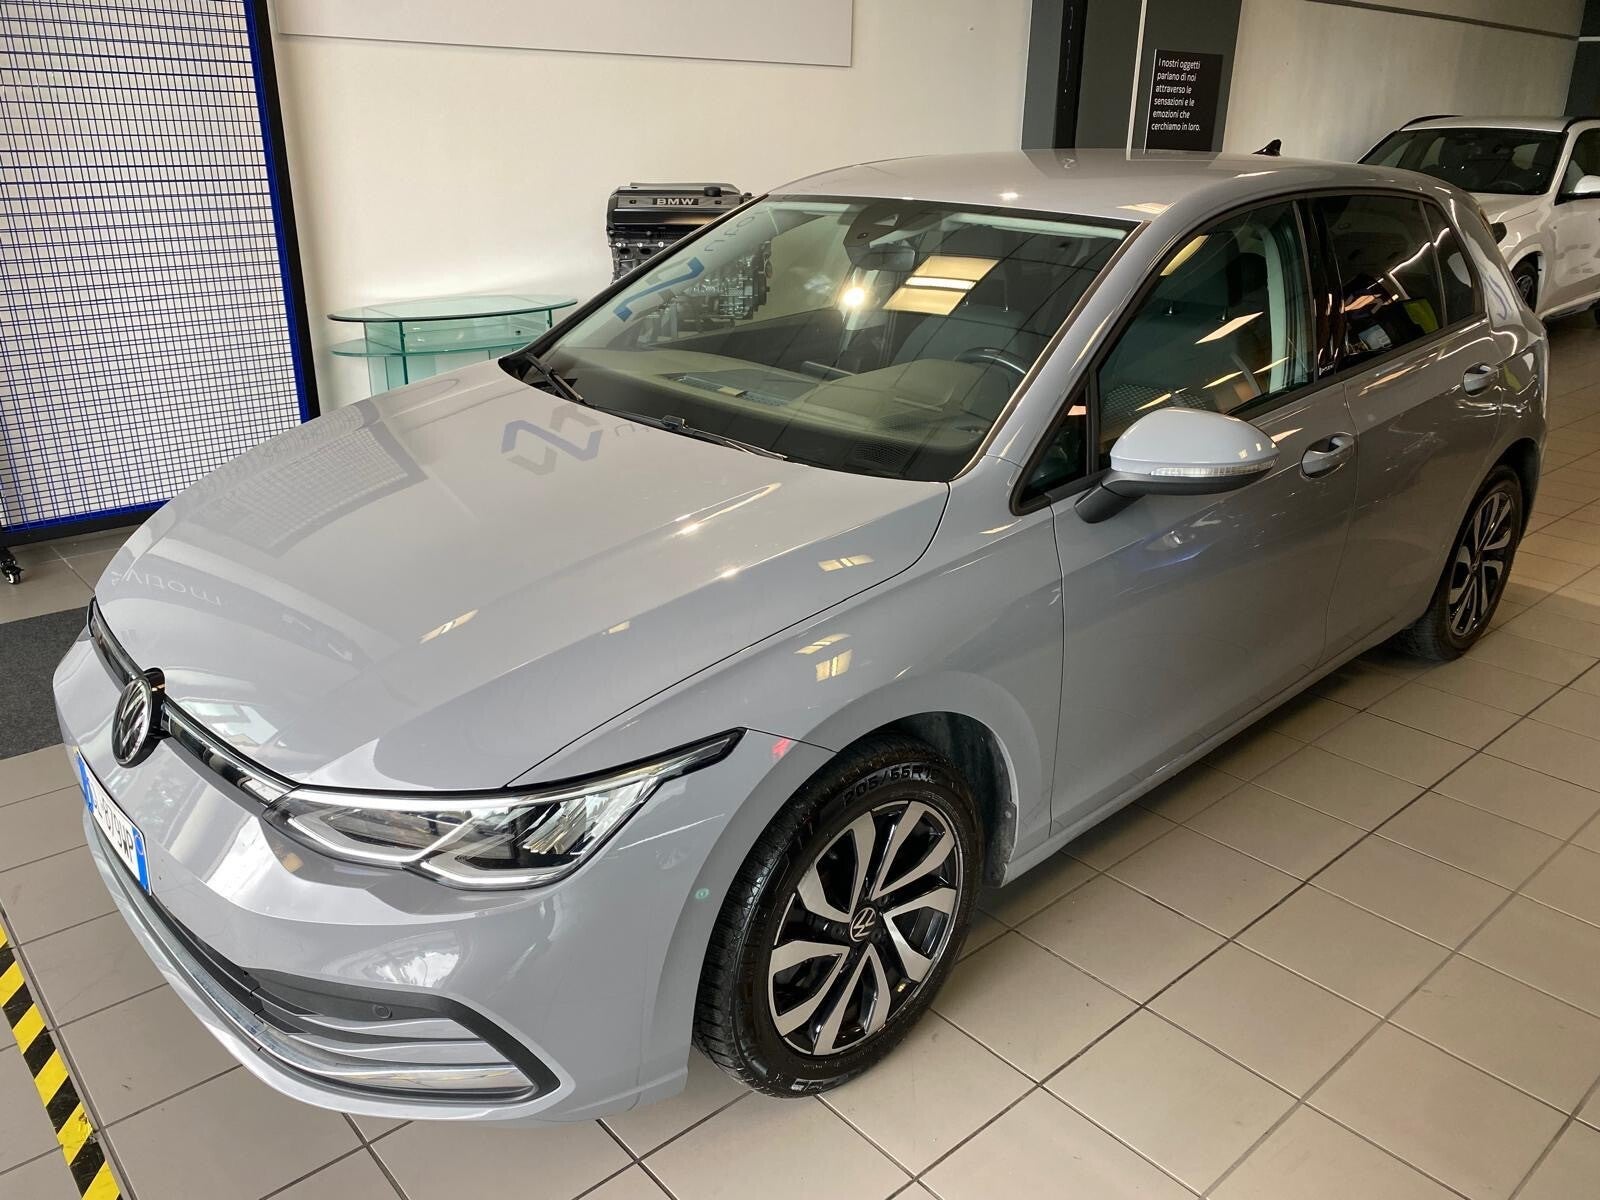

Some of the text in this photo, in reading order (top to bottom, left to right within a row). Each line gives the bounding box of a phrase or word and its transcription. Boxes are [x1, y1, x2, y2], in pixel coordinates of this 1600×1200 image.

[1162, 59, 1180, 67] nostri
[1180, 61, 1200, 71] oggetti
[1156, 71, 1197, 82] parlano di noi
[1155, 84, 1192, 94] attraverso le
[1153, 97, 1184, 106] sensazioni
[1189, 97, 1195, 107] le
[1152, 109, 1190, 119] emozioni che
[1151, 121, 1200, 131] cerchiamo in loro.
[656, 198, 694, 206] BMW
